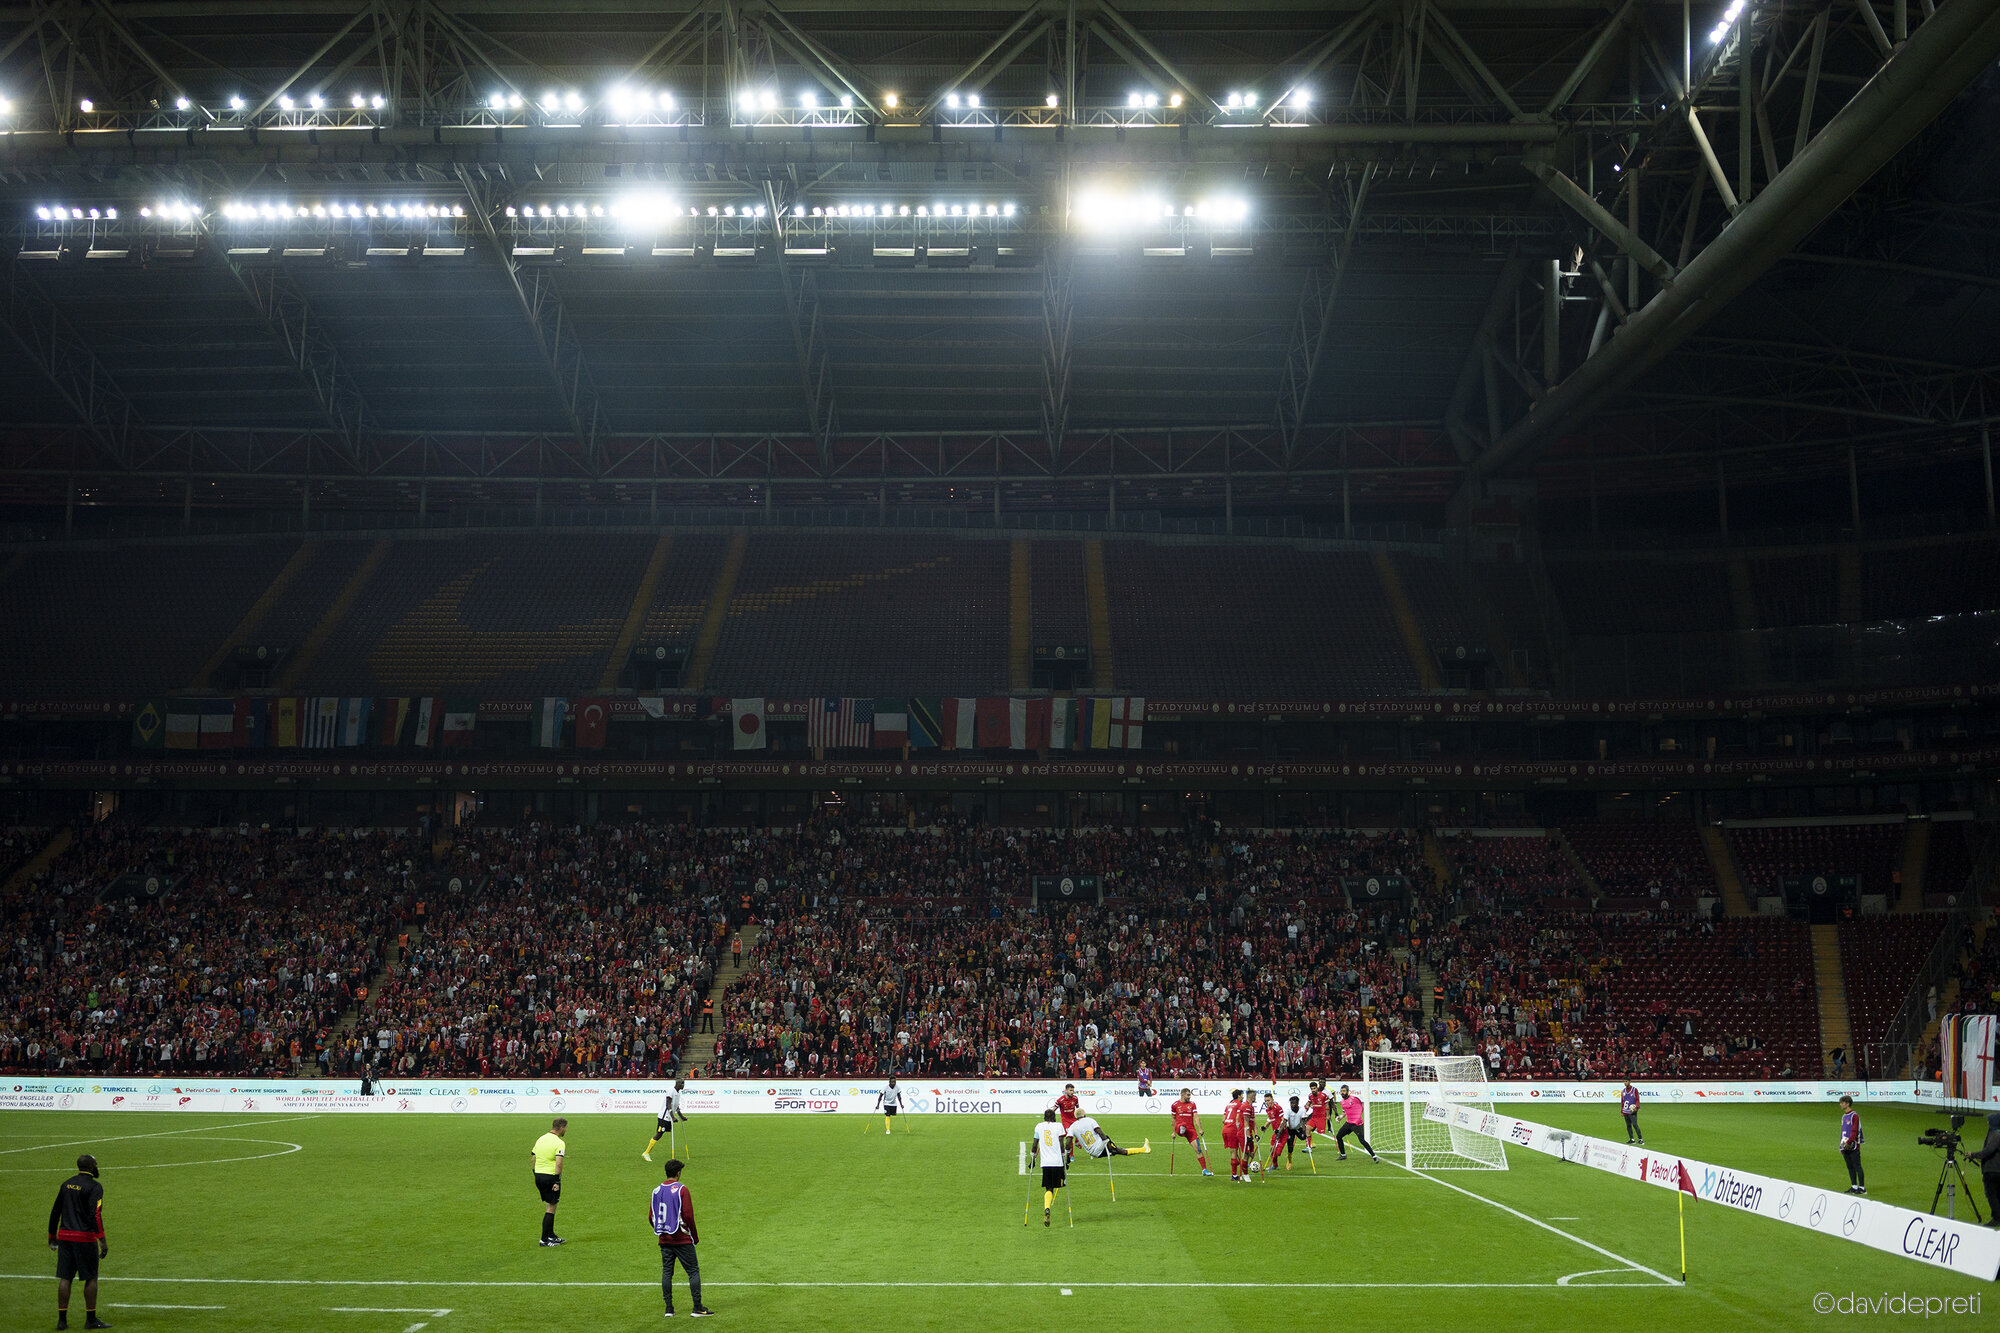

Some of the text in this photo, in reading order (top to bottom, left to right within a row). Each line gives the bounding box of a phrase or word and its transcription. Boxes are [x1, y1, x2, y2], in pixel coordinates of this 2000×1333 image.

[636, 647, 648, 655] 415
[1036, 647, 1047, 655] 416
[40, 703, 100, 711] STADYUMU
[480, 703, 532, 711] STADYUM
[1148, 703, 1209, 711] STADYUMU
[1258, 703, 1320, 711] STADYUMU
[1370, 703, 1431, 711] STADYUMU
[1526, 703, 1589, 711] STADYUMU
[1640, 702, 1704, 710] STADYUMU
[46, 765, 106, 774] STADYUMU
[155, 765, 216, 774] STADYUMU
[268, 765, 330, 774] STADYUMU
[380, 765, 442, 774] STADYUMU
[492, 765, 554, 774] STADYUMU
[603, 765, 665, 774] STADYUMU
[717, 765, 779, 774] STADYUMU
[830, 765, 891, 774] STADYUMU
[941, 765, 1003, 774] STADYUMU
[1052, 765, 1114, 774] STADYUMU
[1166, 765, 1228, 774] STADYUMU
[1277, 765, 1339, 774] STADYUMU
[1389, 765, 1451, 774] STADYUMU
[1504, 765, 1568, 774] STADYUMU
[1618, 764, 1683, 773] STADYUMU
[54, 1085, 84, 1094] CLEAR
[429, 1087, 460, 1096] CLEAR
[810, 1087, 841, 1096] CLEAR
[1190, 1088, 1222, 1096] CLEAR
[1573, 1089, 1605, 1098] CLEAR
[774, 1101, 838, 1110] SPORTOTO
[935, 1098, 1002, 1113] bitexen
[1044, 1130, 1052, 1147] 6
[1650, 1160, 1671, 1182] Petrol
[1714, 1170, 1762, 1210] bitexen
[657, 1202, 667, 1224] 9
[1903, 1217, 1960, 1265] CLEAR
